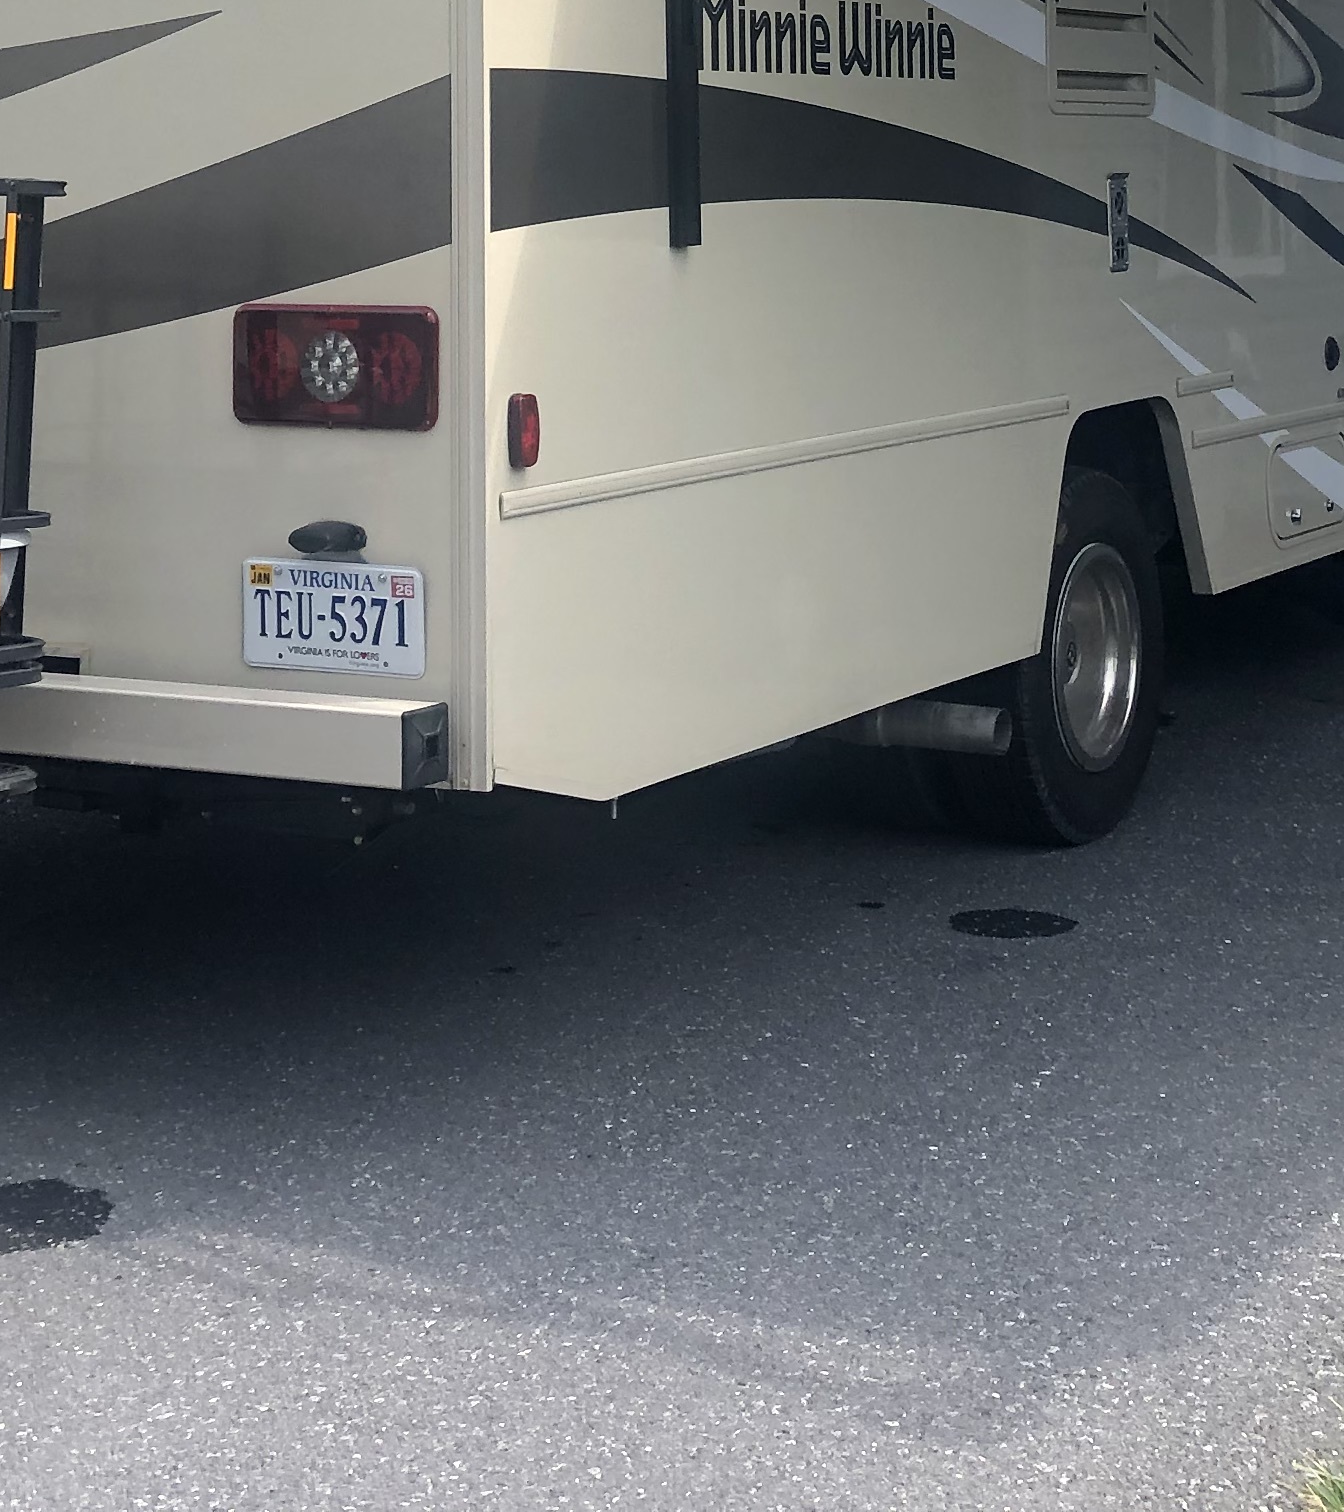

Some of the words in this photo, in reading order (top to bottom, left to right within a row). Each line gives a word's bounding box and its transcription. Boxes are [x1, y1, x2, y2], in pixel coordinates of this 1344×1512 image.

[838, 0, 956, 81] Winnie
[250, 571, 271, 585] JAN
[288, 568, 376, 592] VIRGINIA
[395, 584, 413, 597] 26
[254, 588, 409, 648] TEU-5371
[287, 645, 323, 657] VIRGINIA
[324, 648, 331, 658] IS
[333, 649, 348, 659] FOR
